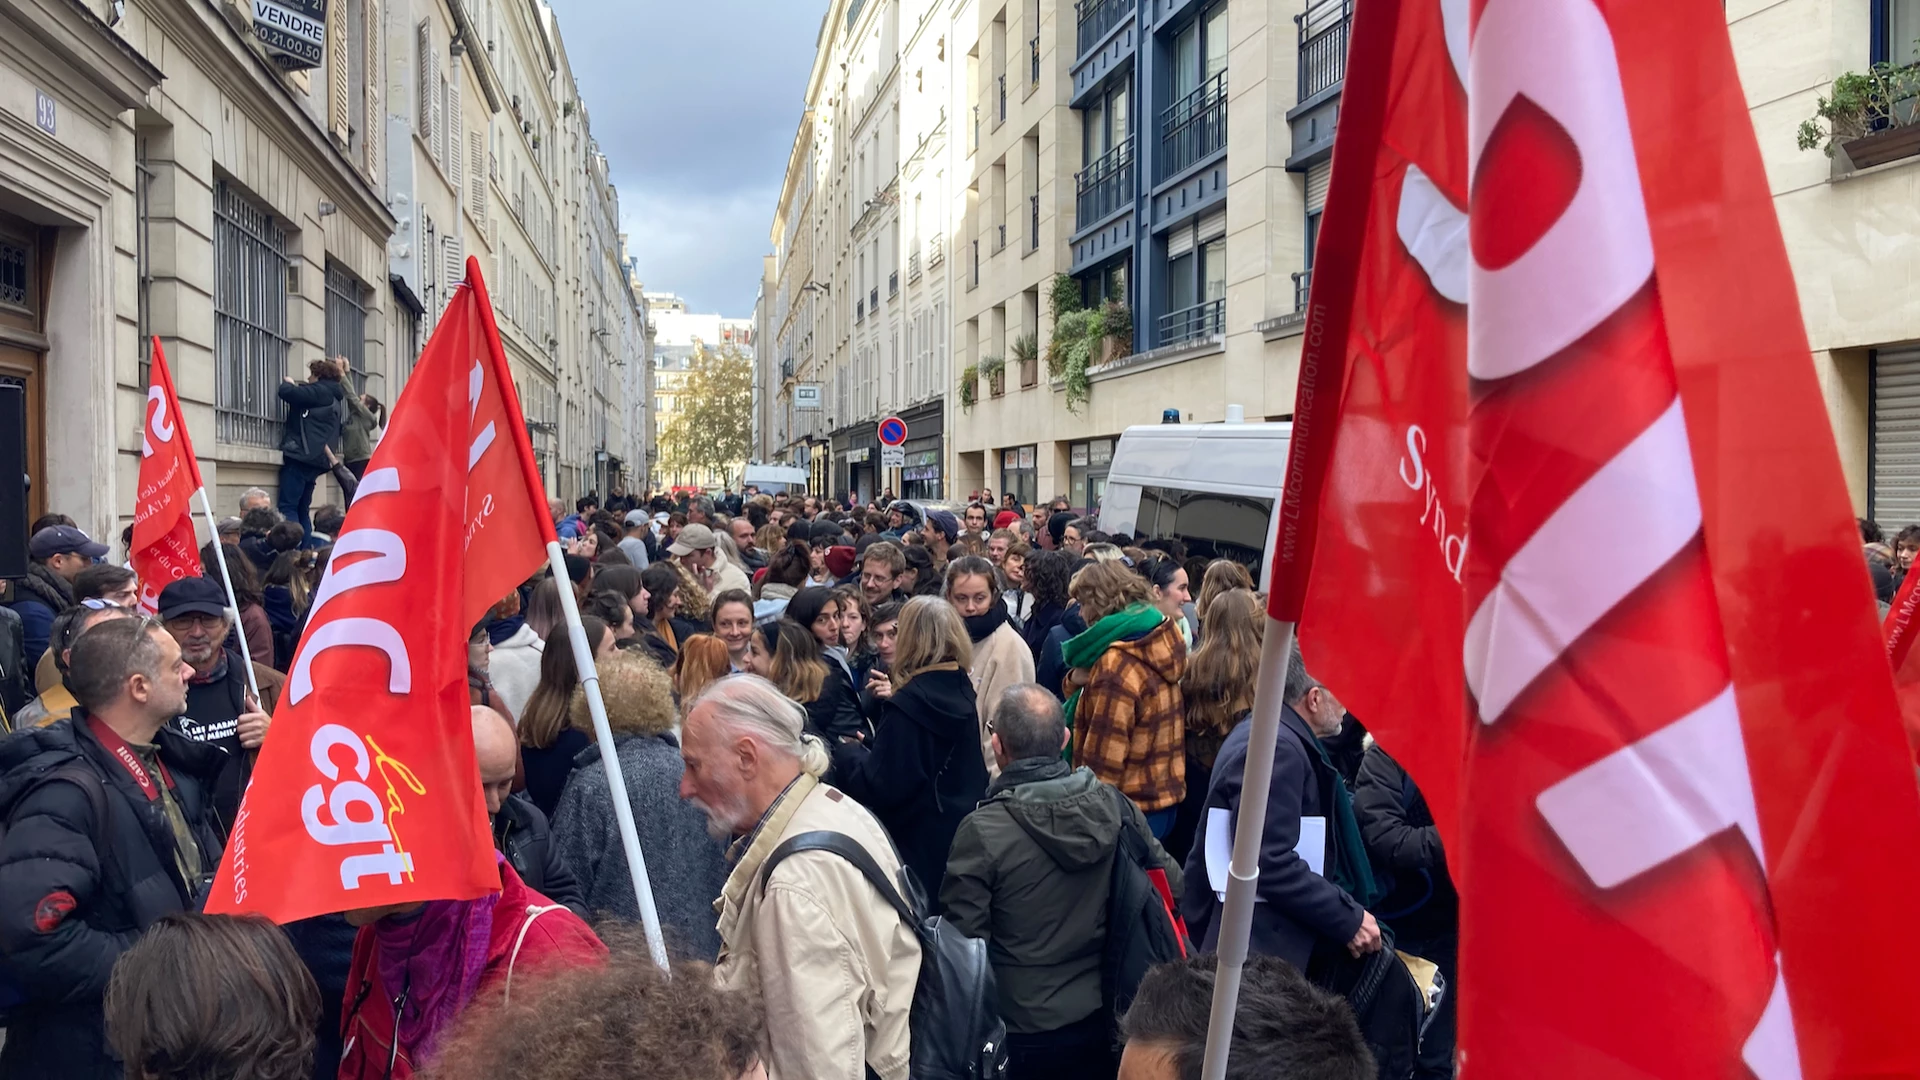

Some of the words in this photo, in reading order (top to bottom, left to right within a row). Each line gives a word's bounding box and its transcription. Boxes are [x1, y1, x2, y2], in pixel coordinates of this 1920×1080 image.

[256, 1, 323, 41] VENDRE
[39, 95, 55, 129] 93
[1282, 304, 1326, 563] www.LMcommunication.com
[150, 546, 161, 557] et
[158, 555, 172, 569] du
[191, 725, 206, 735] LES
[116, 746, 150, 788] Canon
[300, 723, 415, 891] cgt
[365, 734, 427, 883] la
